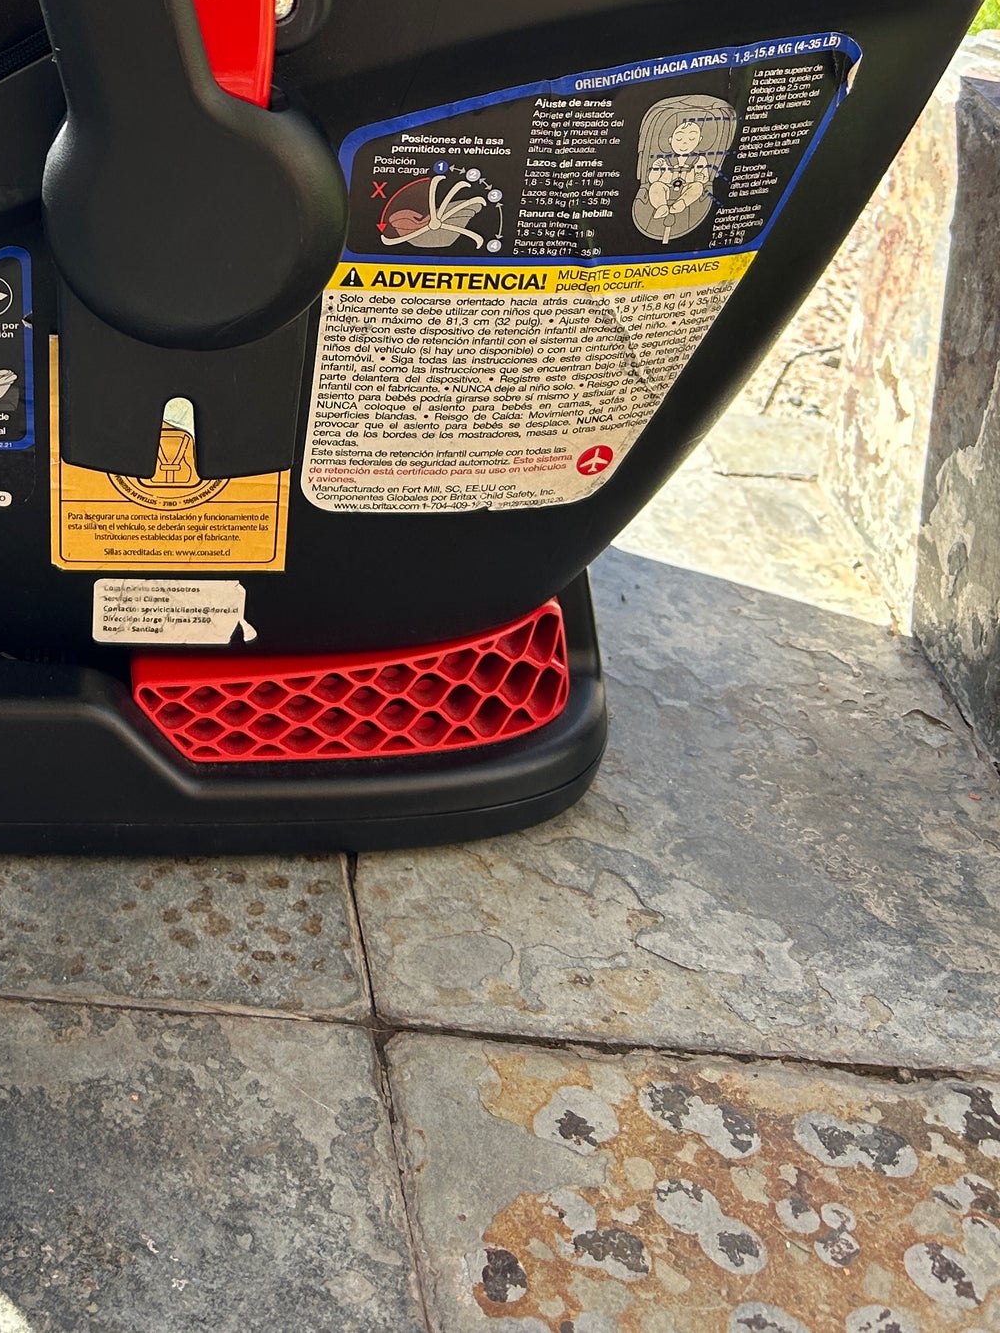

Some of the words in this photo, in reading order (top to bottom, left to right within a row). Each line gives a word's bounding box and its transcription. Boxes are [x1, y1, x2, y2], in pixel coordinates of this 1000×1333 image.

[575, 67, 649, 89] ORIENTACIÓN
[653, 60, 687, 74] HACIA
[690, 53, 727, 67] ATRAS
[735, 46, 775, 62] 1,8-15,8
[777, 42, 791, 54] KG
[794, 38, 821, 53] (4-35
[822, 35, 840, 47] LB)
[534, 98, 566, 108] Ajuste
[568, 98, 581, 106] de
[401, 134, 456, 146] Posiciones
[458, 136, 471, 144] de
[474, 136, 483, 147] la
[485, 138, 503, 148] asa
[391, 145, 445, 153] permitidos
[374, 156, 415, 164] Posición
[526, 158, 556, 167] Lazos
[559, 158, 572, 168] del
[372, 166, 395, 174] para
[397, 167, 429, 175] cargar
[518, 209, 554, 217] Ranura
[556, 210, 569, 218] de
[572, 211, 580, 219] la
[581, 209, 612, 217] hebilla
[558, 269, 610, 281] MUERTE
[612, 270, 620, 278] o
[624, 266, 668, 278] DAÑOS
[671, 260, 719, 274] GRAVES
[372, 271, 546, 289] ADVERTENCIA!
[555, 282, 600, 292] pueden
[2, 323, 18, 332] por
[311, 448, 333, 459] Este
[335, 449, 372, 459] sistema
[374, 449, 387, 457] de
[468, 449, 503, 457] cumple
[505, 449, 523, 458] con
[525, 447, 551, 456] todas
[553, 446, 566, 456] las
[316, 476, 356, 485] aviones.
[311, 484, 384, 494] Manufacturado
[387, 487, 399, 495] en
[401, 485, 421, 495] Fort
[498, 484, 516, 493] con
[315, 492, 383, 503] Componentes
[386, 492, 428, 504] Globales
[430, 492, 447, 504] por
[449, 493, 476, 504] Britax
[108, 522, 114, 532] el
[186, 524, 208, 532] seguir
[183, 534, 195, 542] por
